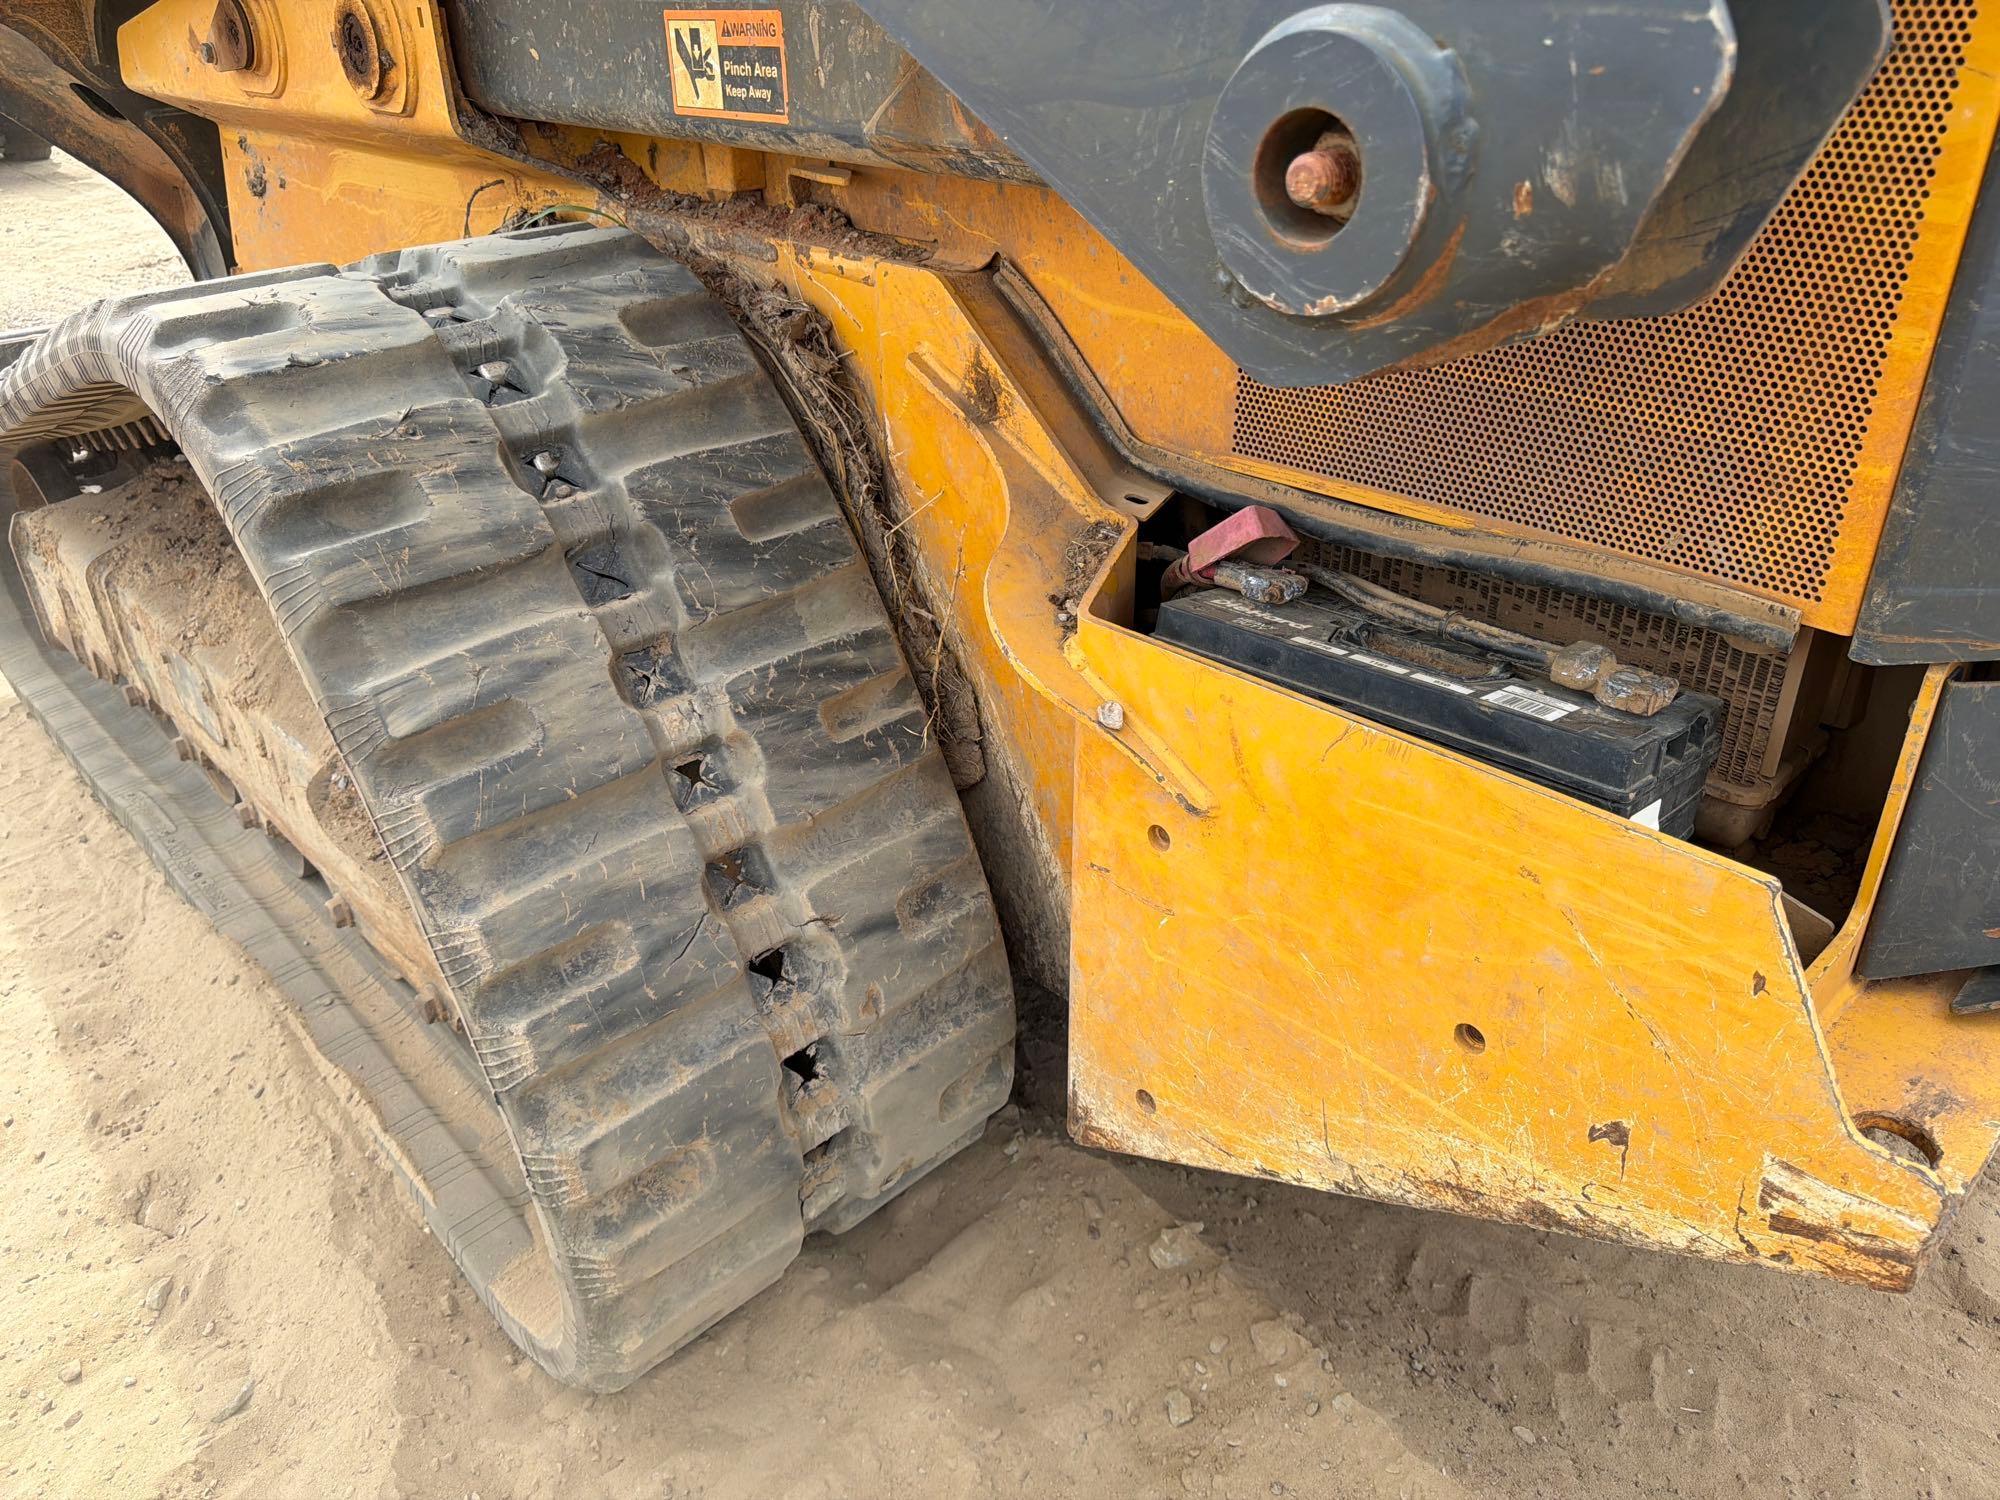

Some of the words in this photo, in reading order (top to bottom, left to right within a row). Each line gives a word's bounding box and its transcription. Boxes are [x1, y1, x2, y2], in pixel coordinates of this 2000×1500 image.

[730, 22, 776, 37] WARNING
[723, 60, 752, 77] Pinch
[754, 61, 778, 78] Area
[725, 83, 747, 100] Keep
[748, 85, 772, 102] Away
[1209, 598, 1313, 630] DieHard
